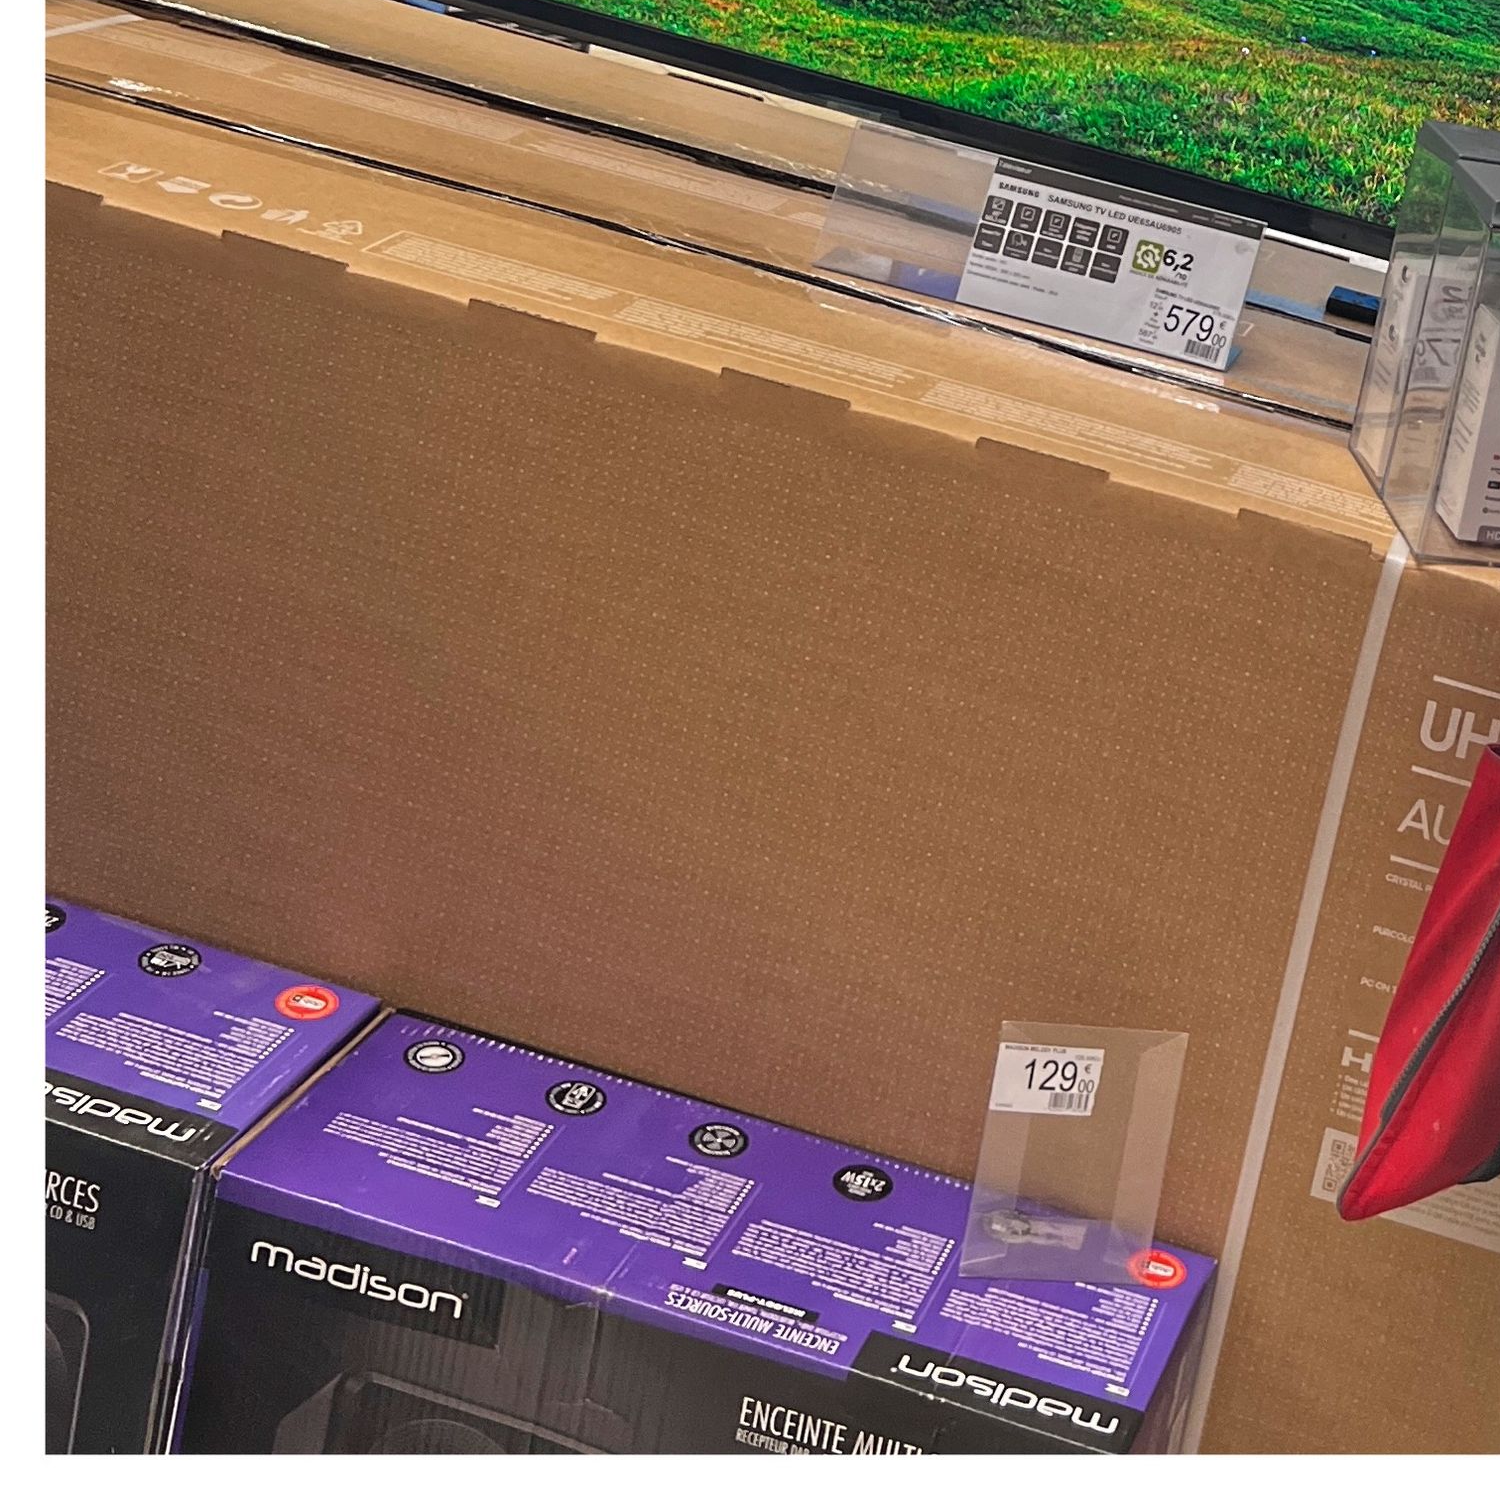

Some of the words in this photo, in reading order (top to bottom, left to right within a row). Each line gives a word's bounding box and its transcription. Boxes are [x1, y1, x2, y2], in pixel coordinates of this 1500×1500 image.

[998, 181, 1040, 198] SAMSUNG
[1047, 194, 1093, 213] SAMSUNG
[1094, 206, 1107, 216] TV
[1108, 209, 1126, 222] LED
[1162, 249, 1194, 271] 6,2
[1163, 304, 1215, 342] 579
[1211, 333, 1227, 349] 00
[1385, 872, 1424, 892] CRYSTAL
[1372, 925, 1415, 945] PURCOLO
[1025, 1058, 1078, 1092] 129
[1077, 1079, 1095, 1094] 00
[45, 1081, 198, 1144] madis
[46, 1171, 101, 1213] RCES
[50, 1204, 64, 1220] CD
[64, 1209, 74, 1224] &
[75, 1212, 96, 1230] USB
[249, 1239, 464, 1320] madison
[664, 1290, 775, 1335] MULTI-SOURCES
[772, 1323, 841, 1355] ENCEINTE
[898, 1352, 1119, 1437] madison
[739, 1396, 848, 1454] ENCEINTE
[851, 1430, 924, 1455] MULT
